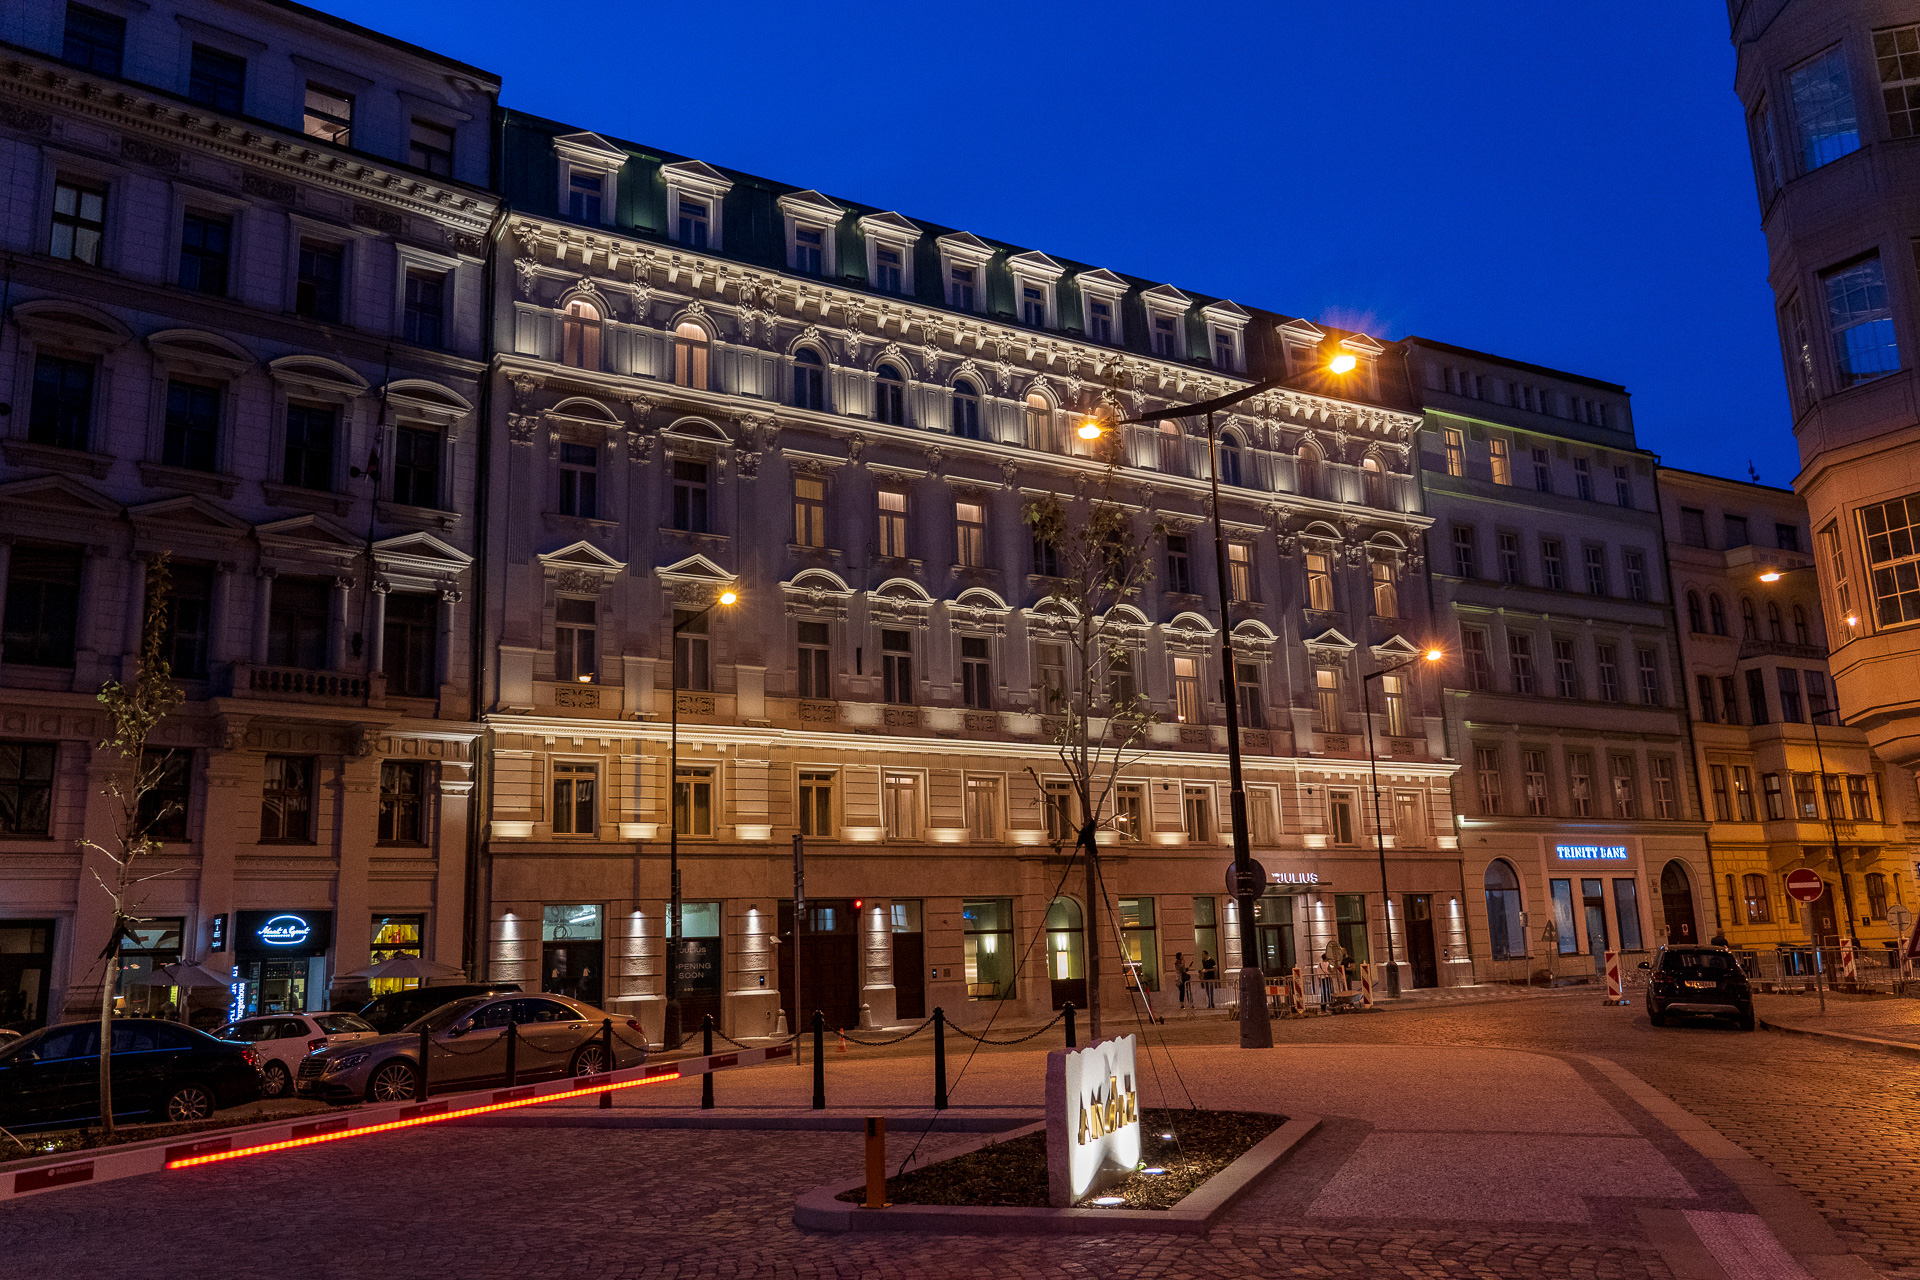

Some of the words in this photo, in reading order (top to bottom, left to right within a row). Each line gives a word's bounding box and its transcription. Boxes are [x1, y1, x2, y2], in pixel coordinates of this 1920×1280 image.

[1556, 846, 1598, 859] TRINITY
[1600, 846, 1627, 859] BANK
[1277, 872, 1319, 884] JULIUS
[675, 962, 712, 970] PENING
[678, 971, 705, 979] SOON
